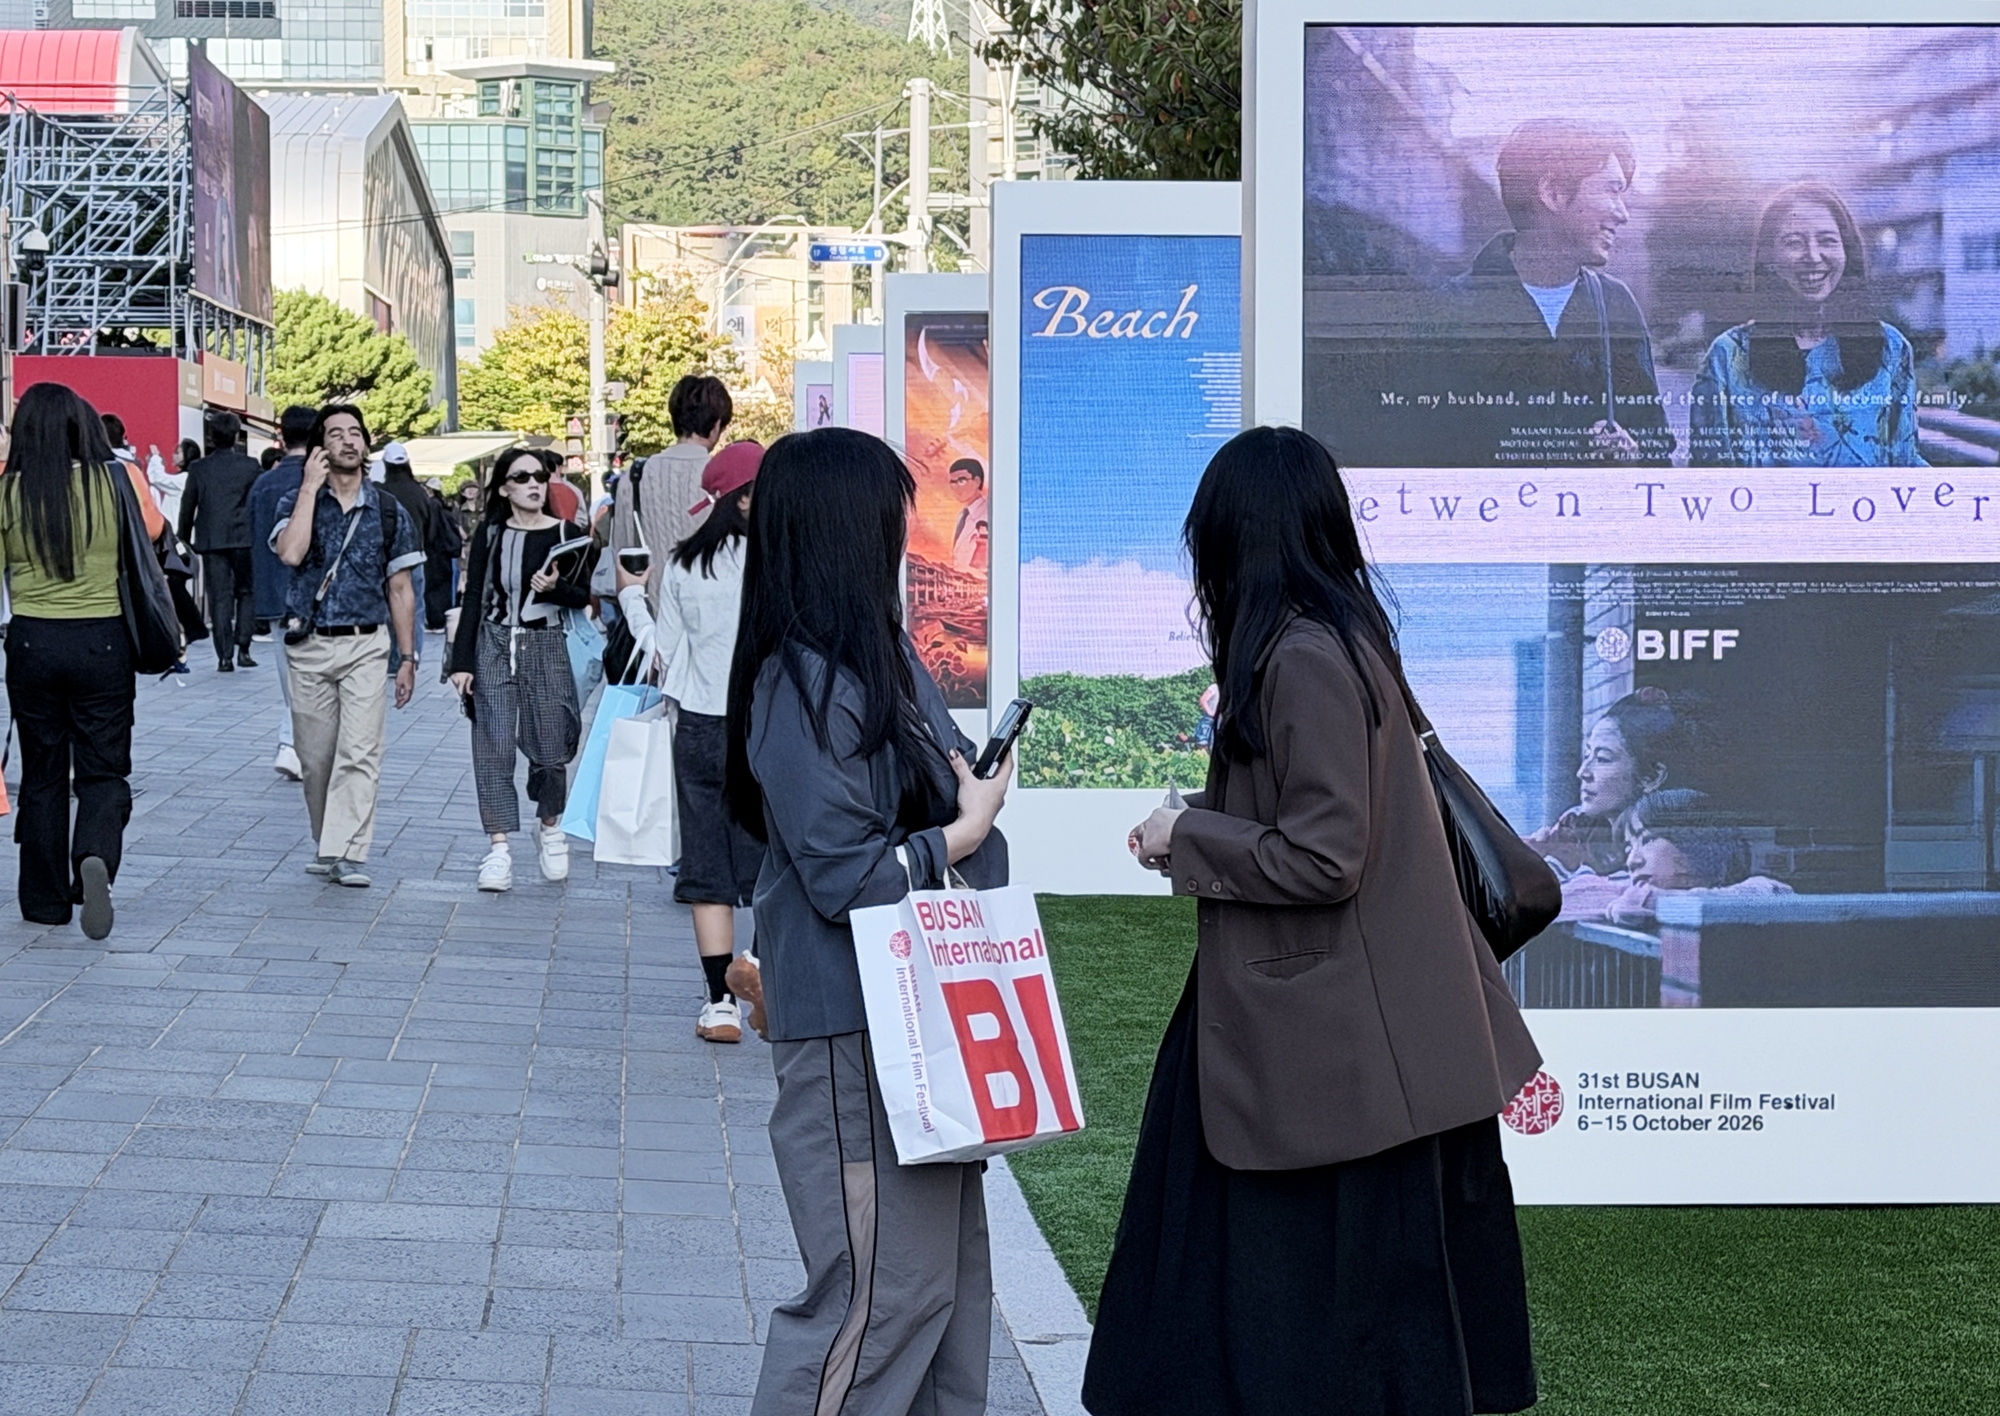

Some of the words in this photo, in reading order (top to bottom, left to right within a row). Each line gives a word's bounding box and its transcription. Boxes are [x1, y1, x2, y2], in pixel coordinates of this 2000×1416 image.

[1032, 284, 1199, 339] Beach
[1381, 392, 1409, 406] Me,
[1417, 395, 1441, 410] my
[1527, 391, 1556, 405] and
[1615, 391, 1673, 405] wanted
[1679, 391, 1705, 405] the
[1712, 391, 1754, 405] three
[1761, 391, 1780, 405] of
[1809, 392, 1826, 405] to
[1832, 391, 1893, 405] become
[1900, 395, 1908, 405] a
[1915, 391, 1972, 409] family.
[1359, 481, 1582, 522] etween
[1635, 483, 1753, 522] Two
[1808, 481, 1990, 522] Lover
[1637, 629, 1740, 660] BIFF
[916, 900, 985, 931] BUSAN
[927, 928, 1044, 967] Internatonal
[896, 967, 920, 1050] International
[911, 1052, 924, 1081] Film
[940, 974, 1080, 1144] BI
[1578, 1072, 1620, 1089] 31st
[1626, 1072, 1700, 1089] BUSAN
[915, 1083, 935, 1134] Festival
[1578, 1093, 1703, 1110] International
[1710, 1093, 1752, 1110] Film
[1759, 1093, 1836, 1110] Festival
[1632, 1114, 1712, 1131] October
[1717, 1114, 1765, 1131] 2026
